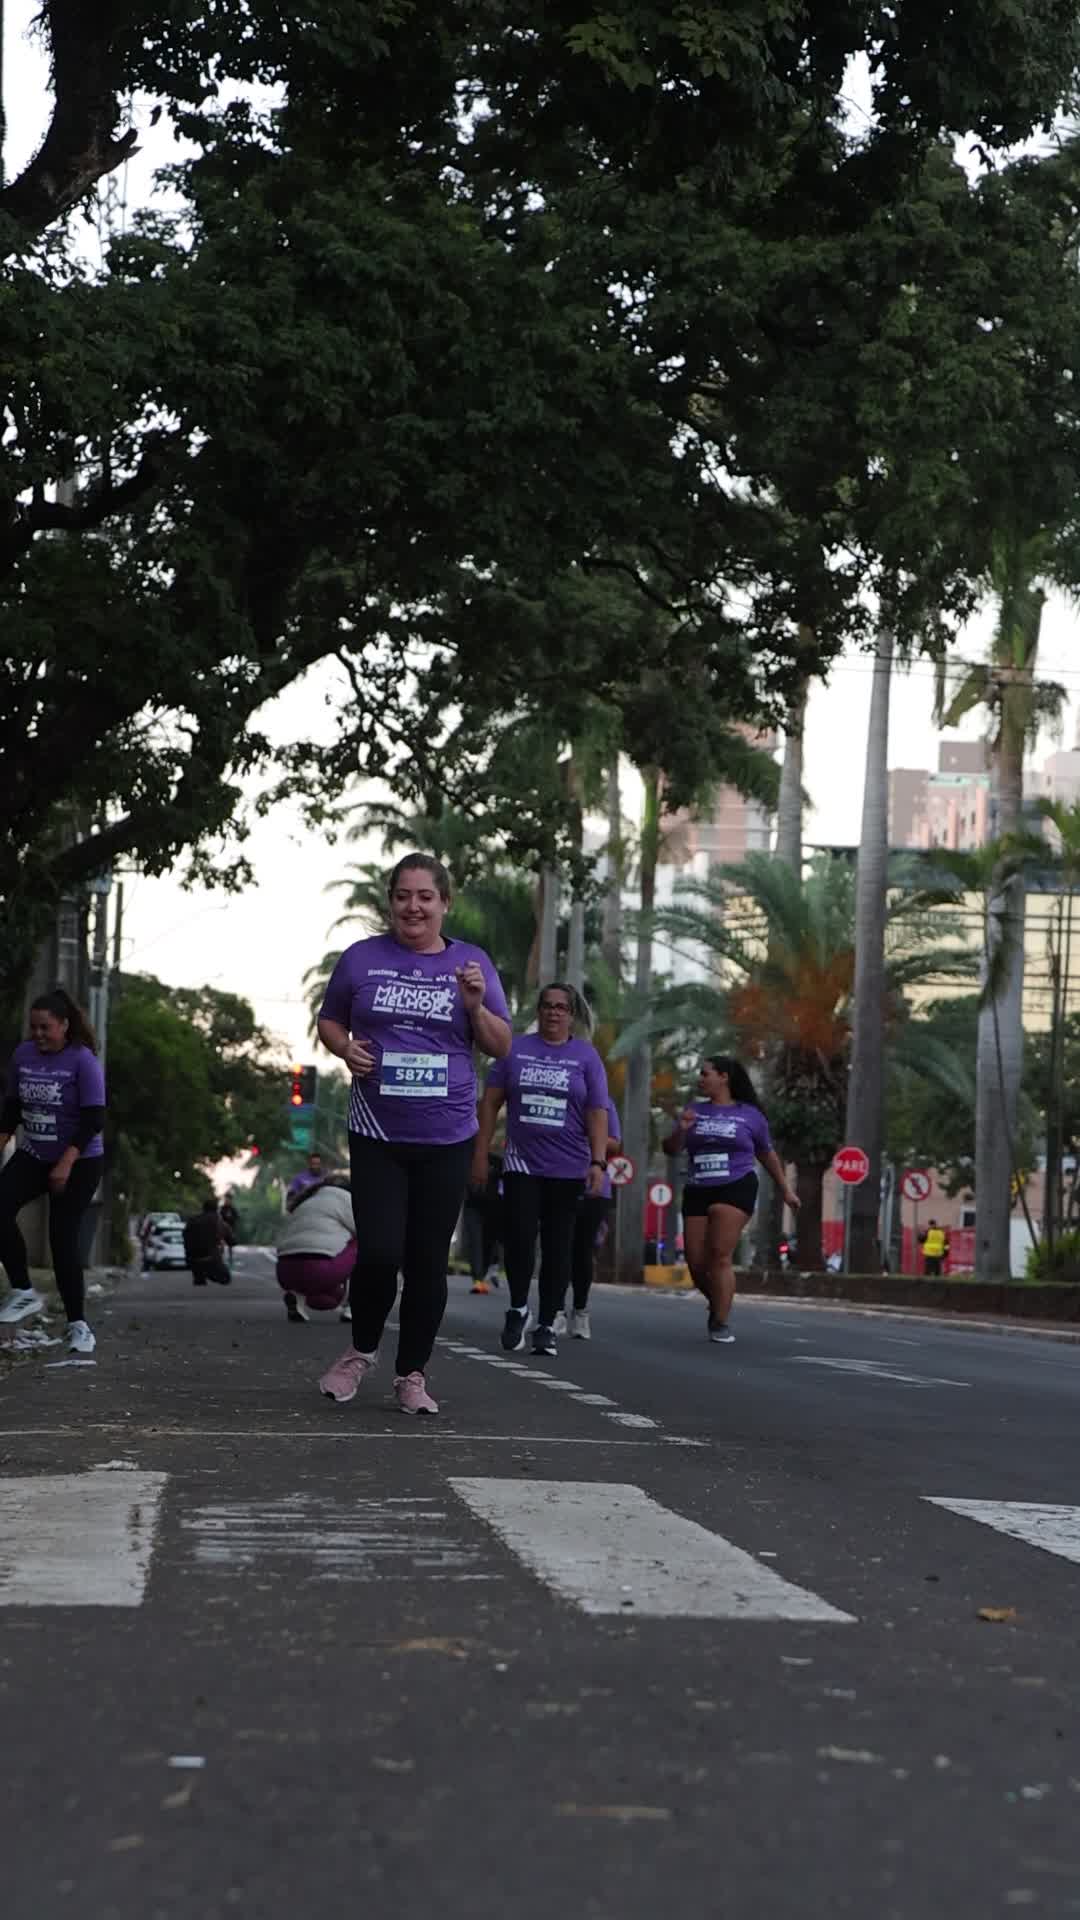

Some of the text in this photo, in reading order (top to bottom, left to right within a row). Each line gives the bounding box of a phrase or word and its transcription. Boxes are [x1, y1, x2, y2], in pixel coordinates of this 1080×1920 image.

[375, 985, 446, 1001] MUNDO
[373, 994, 443, 1013] MELHOR
[395, 1068, 434, 1081] 5874
[834, 1159, 866, 1170] PARE
